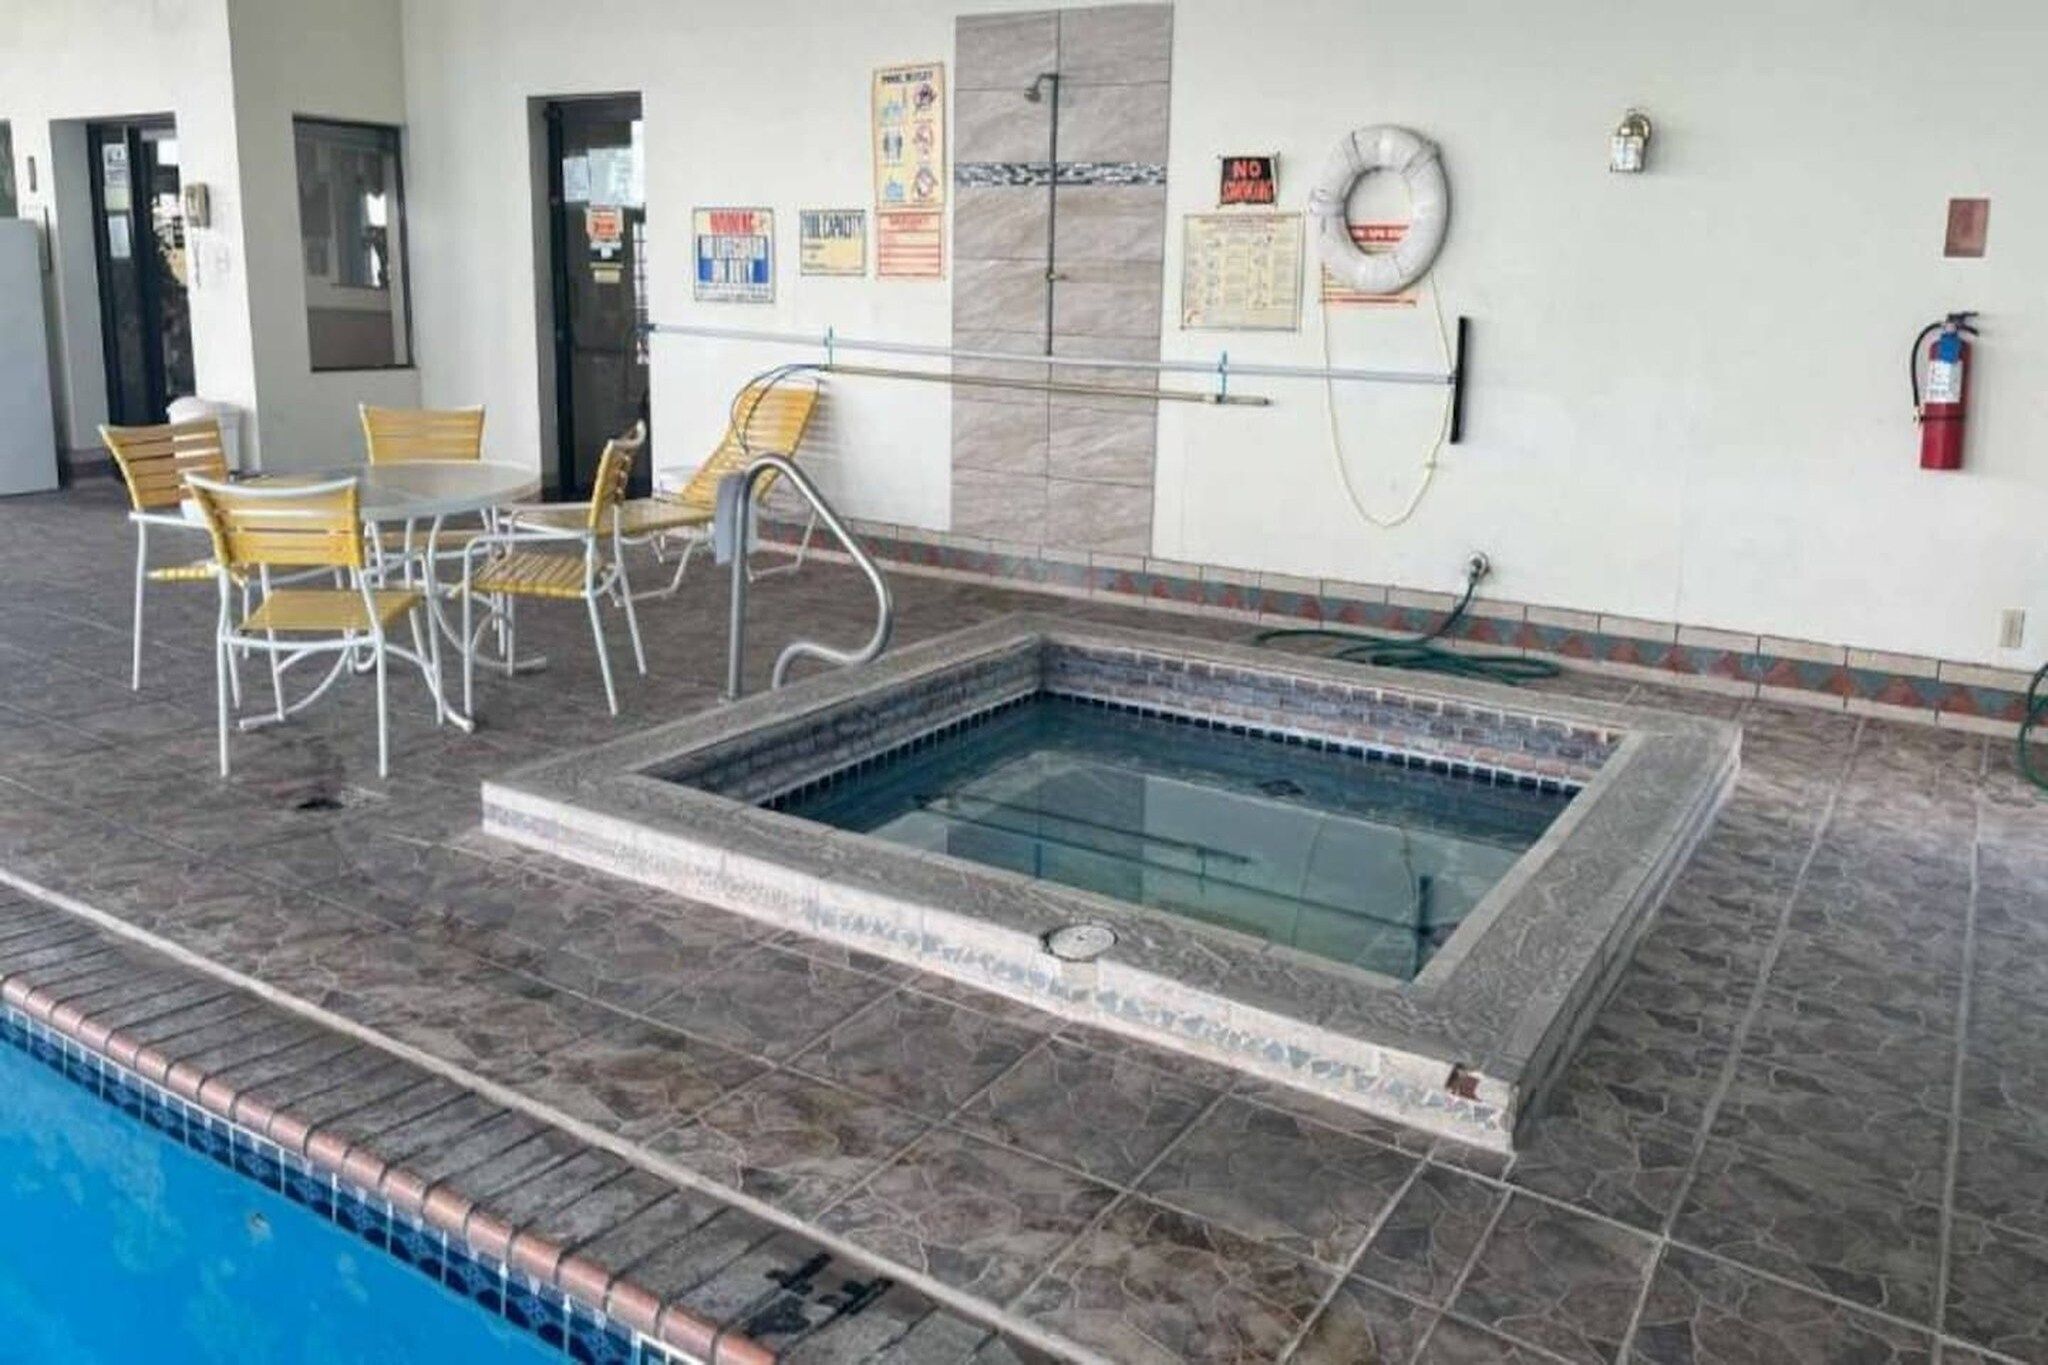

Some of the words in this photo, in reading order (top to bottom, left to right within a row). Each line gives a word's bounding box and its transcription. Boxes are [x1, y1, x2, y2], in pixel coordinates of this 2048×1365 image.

[1232, 160, 1261, 178] NO
[1223, 180, 1272, 202] SMOKING
[823, 212, 863, 239] CAPACITY
